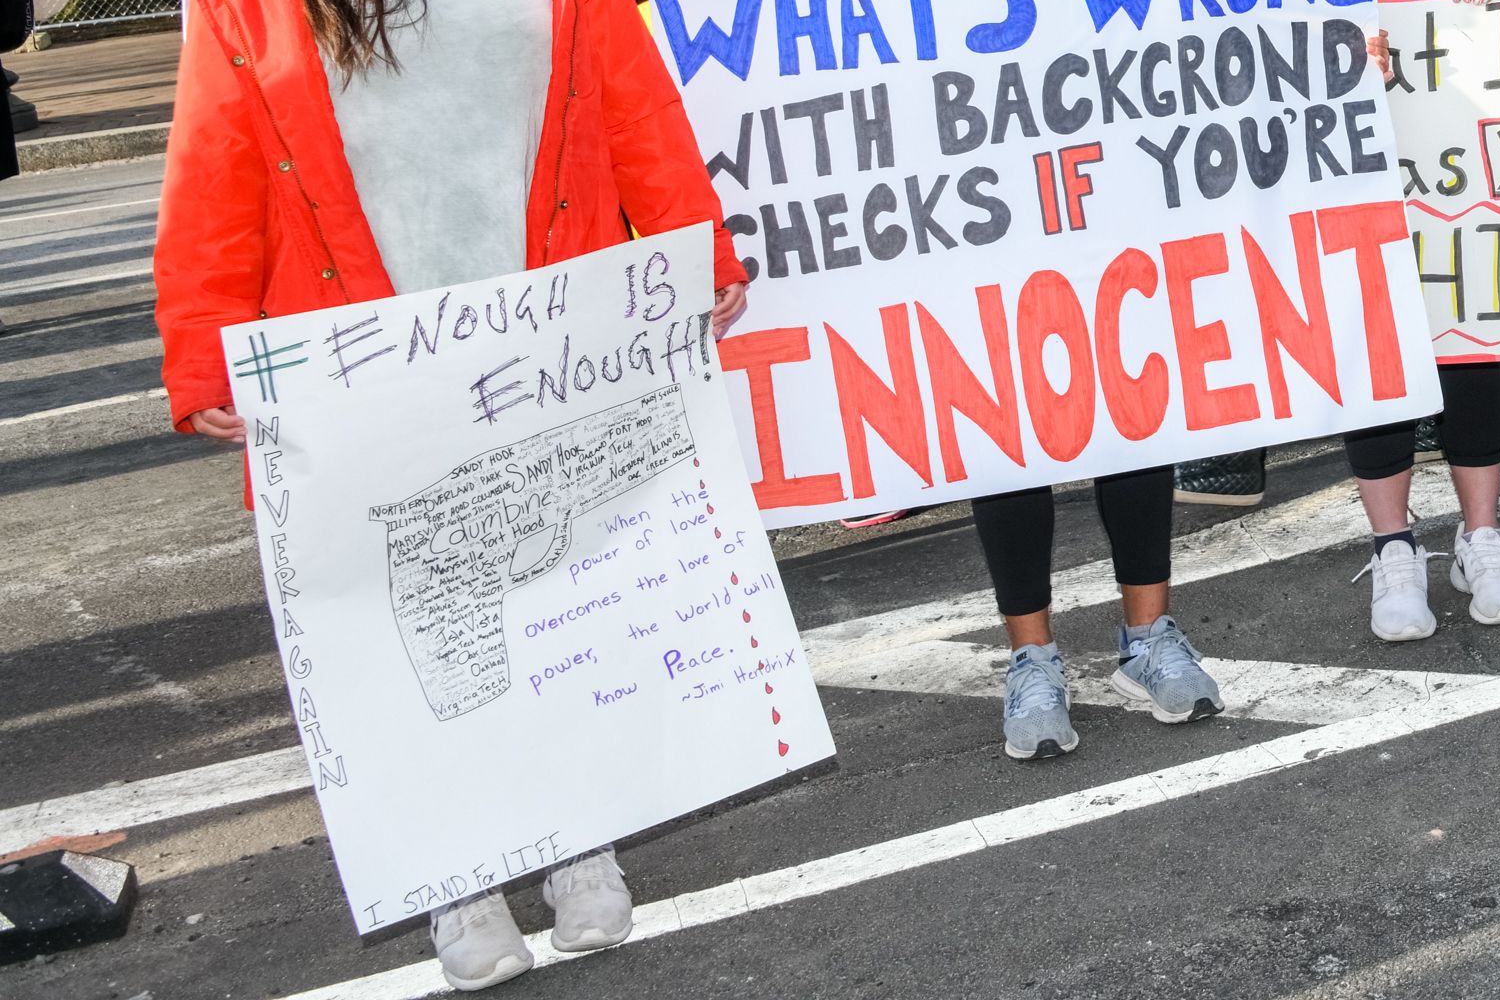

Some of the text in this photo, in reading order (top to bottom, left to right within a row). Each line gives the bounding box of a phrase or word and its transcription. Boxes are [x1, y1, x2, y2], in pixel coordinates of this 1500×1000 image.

[707, 18, 1364, 191] WITH BACKGROND
[726, 100, 1388, 283] CHECKS IF YOU'RE
[1398, 145, 1466, 198] as
[624, 251, 676, 322] IS
[468, 311, 714, 426] ENOUGH!
[720, 200, 1410, 512] INNOCENT
[451, 447, 515, 479] SANDY HOOK
[608, 423, 632, 439] FORT
[425, 470, 503, 512] OVERLAND PARK
[505, 455, 554, 493] SANDY
[556, 442, 585, 467] HOOK
[671, 489, 709, 508] the
[480, 513, 545, 549] Fort Hood
[569, 512, 708, 585] power of love
[524, 530, 747, 638] overcomes the love of
[627, 622, 660, 641] the
[743, 573, 775, 597] will
[662, 645, 735, 680] Peace.
[363, 900, 386, 928] I
[403, 875, 468, 914] STAND
[502, 831, 571, 879] LIFE
